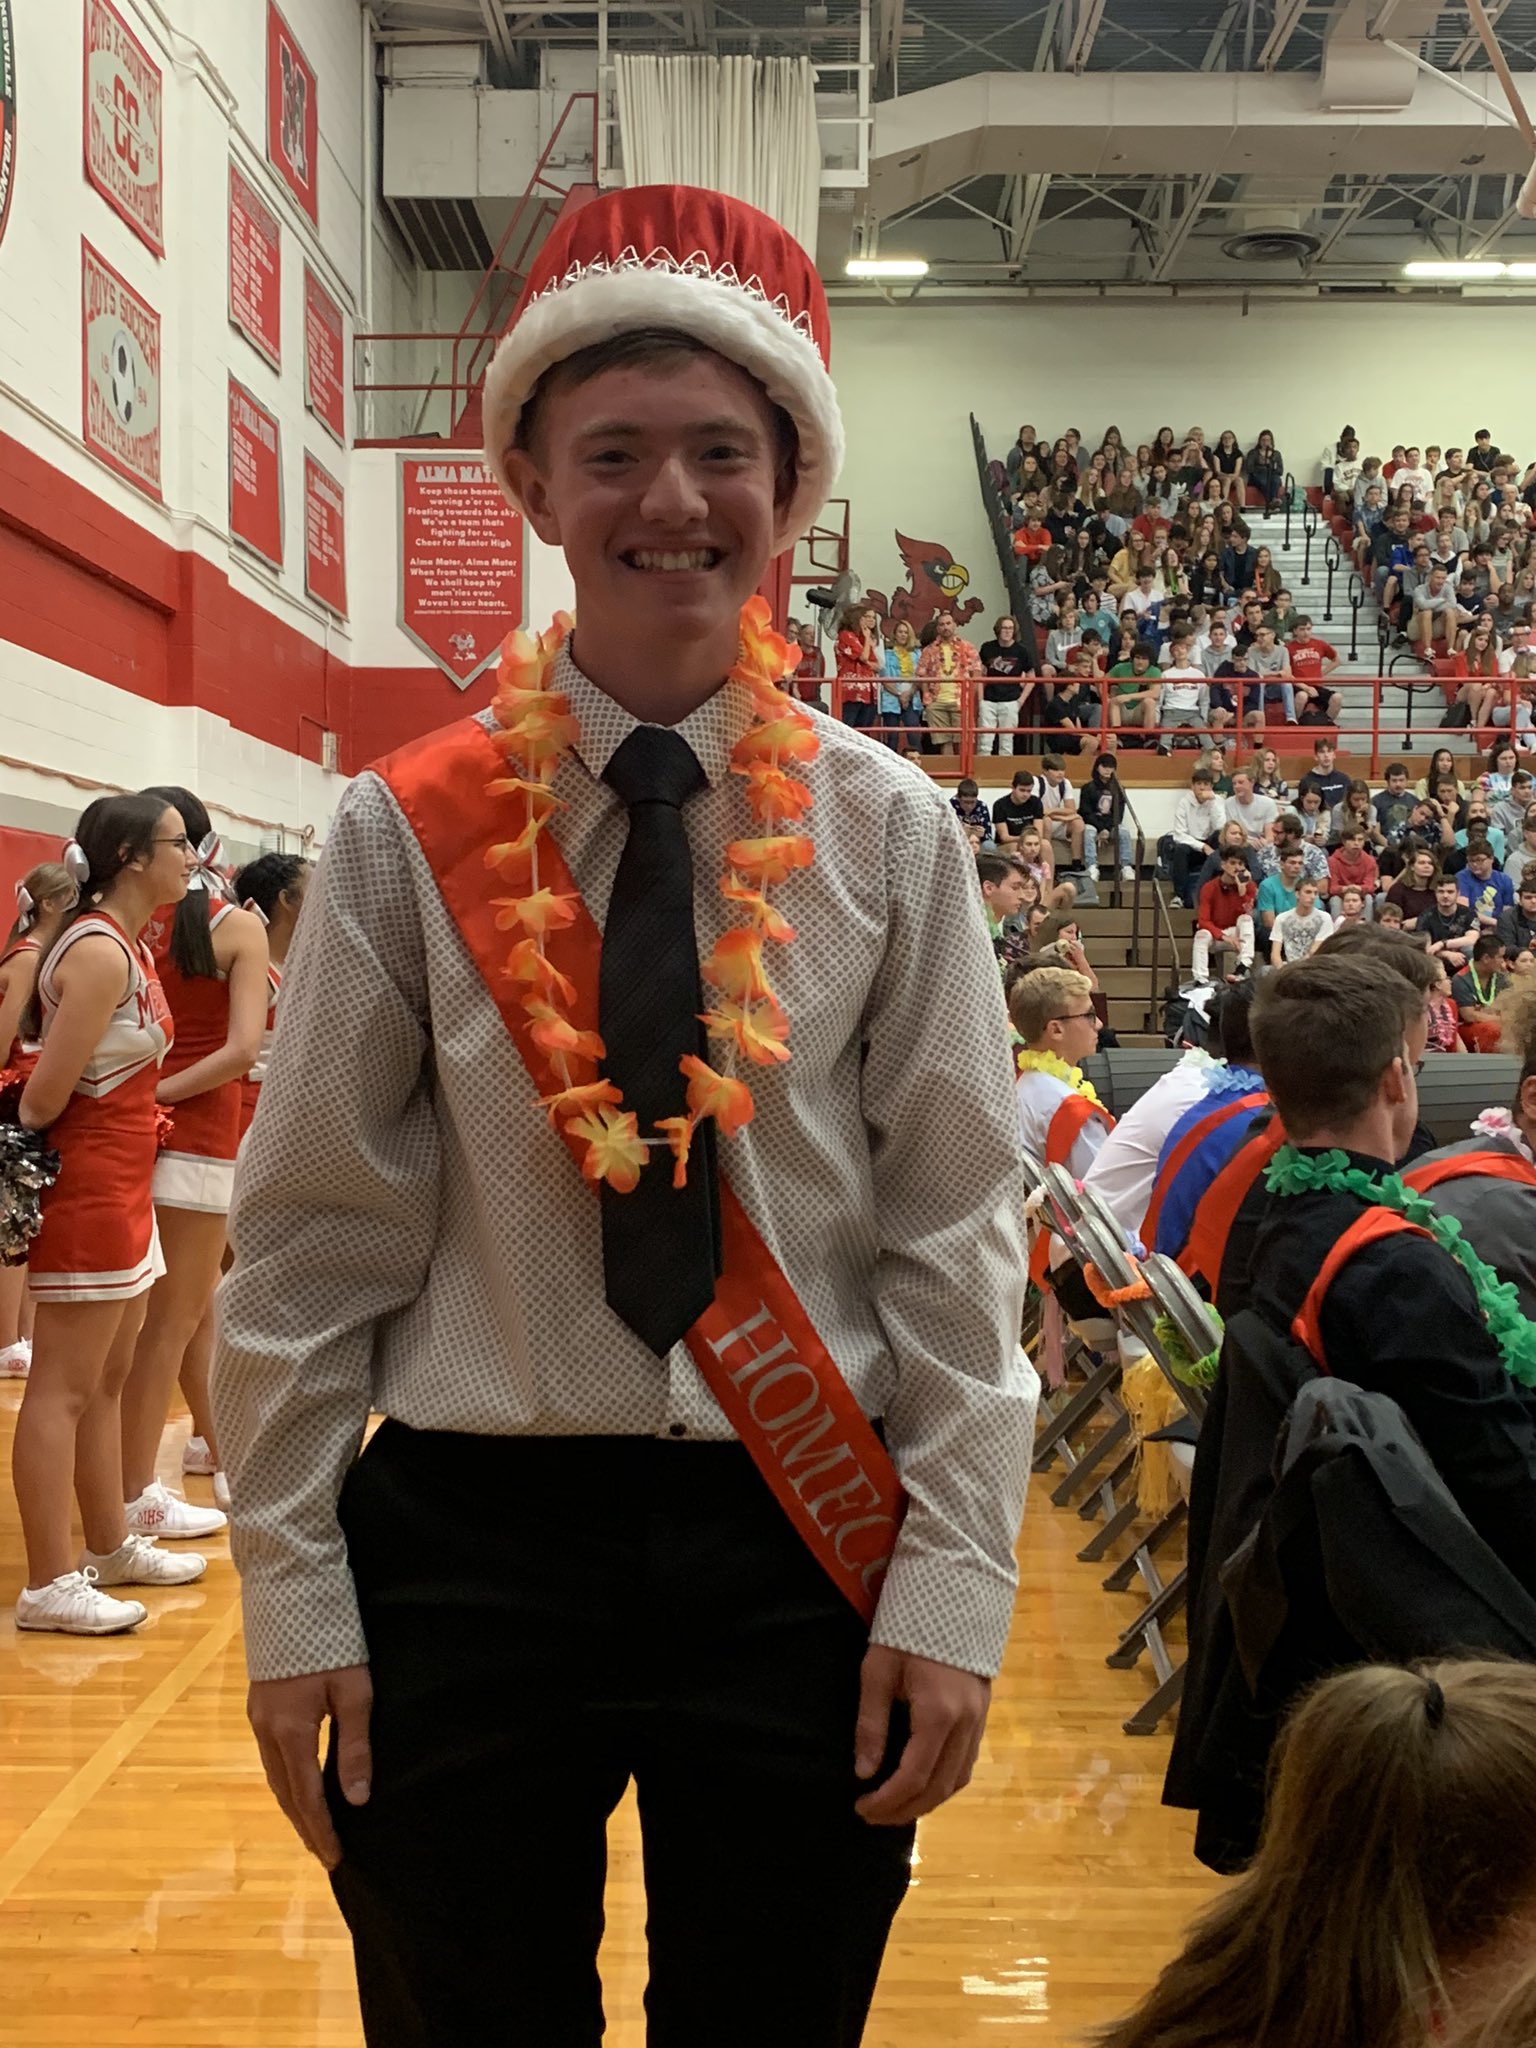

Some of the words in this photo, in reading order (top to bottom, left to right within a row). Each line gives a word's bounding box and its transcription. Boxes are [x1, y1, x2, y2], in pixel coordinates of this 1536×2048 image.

[416, 466, 457, 483] ALMA
[420, 487, 442, 496] Keep
[444, 487, 468, 495] these
[429, 498, 463, 507] waving
[408, 507, 444, 517] Floating
[446, 508, 482, 516] towards
[484, 508, 498, 516] the
[422, 517, 449, 526] We've
[431, 528, 466, 538] fighting
[467, 528, 481, 536] for
[415, 538, 441, 546] Cheer
[443, 538, 456, 546] for
[491, 539, 512, 549] High
[410, 558, 433, 566] Alma
[466, 558, 489, 566] Alma
[491, 558, 517, 566] Mater
[410, 568, 434, 576] When
[436, 568, 458, 576] from
[459, 568, 478, 576] thee
[424, 578, 439, 586] We
[464, 578, 485, 588] keep
[487, 579, 501, 588] thy
[418, 598, 449, 607] Woven
[450, 599, 460, 607] in
[138, 1508, 164, 1525] MHS
